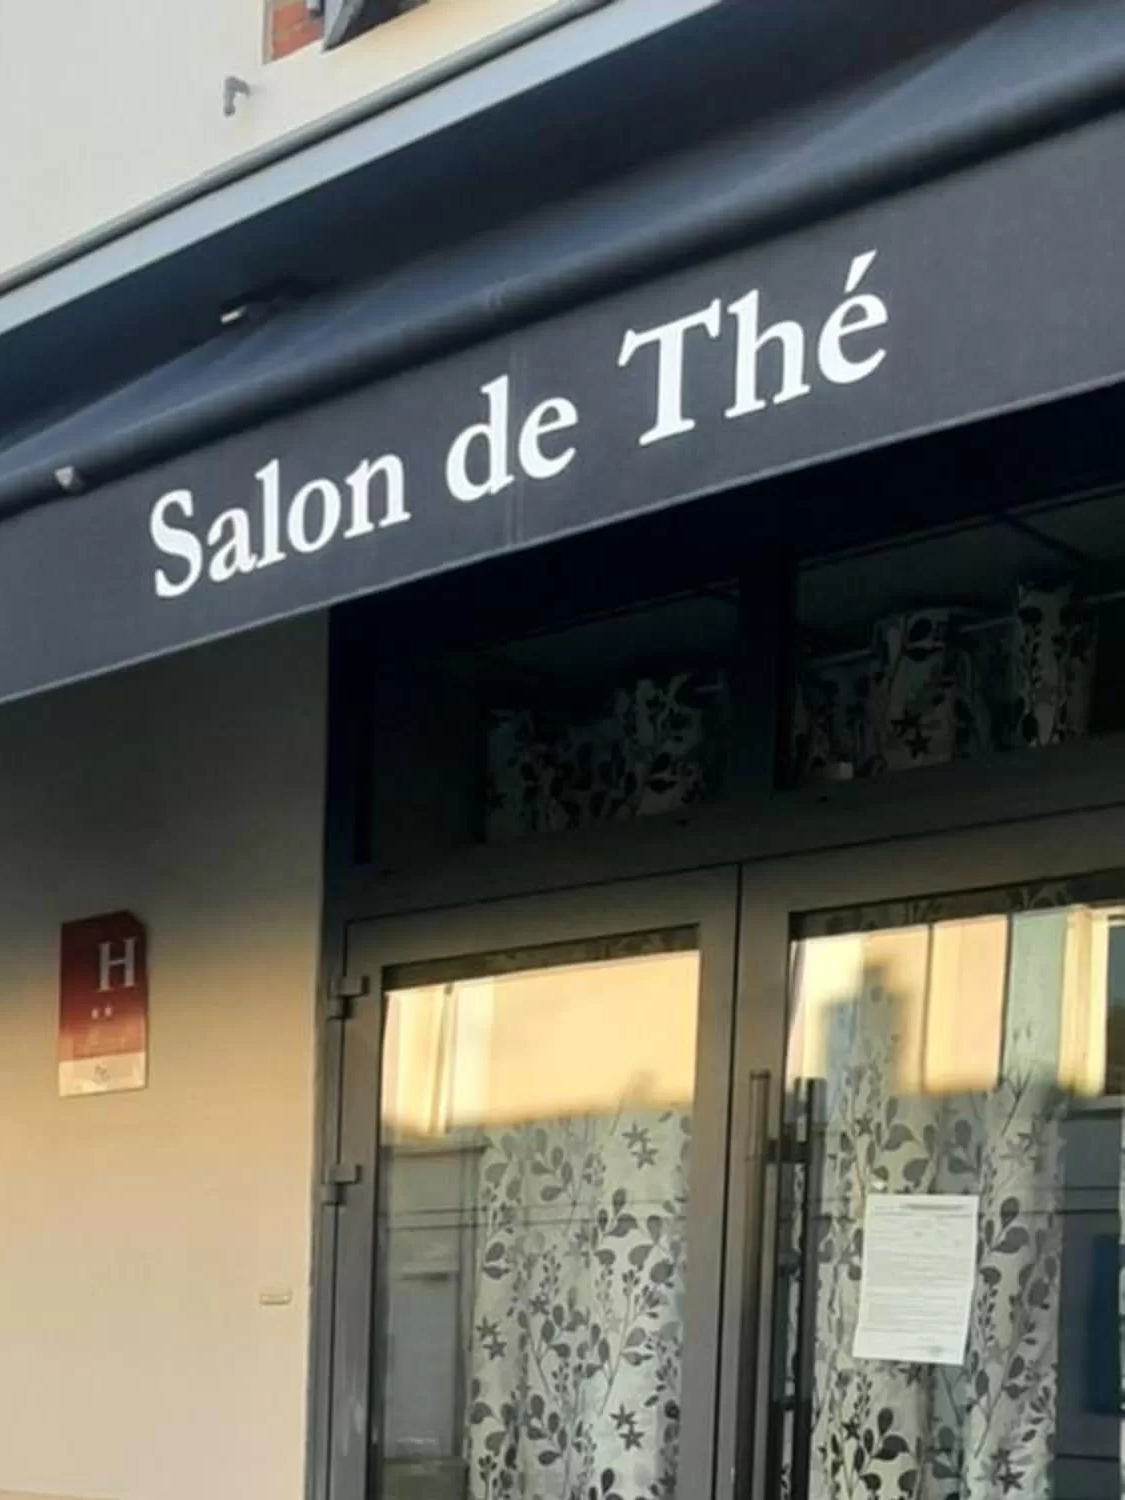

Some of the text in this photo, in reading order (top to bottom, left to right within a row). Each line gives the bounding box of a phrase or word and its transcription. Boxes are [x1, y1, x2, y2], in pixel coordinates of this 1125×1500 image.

[149, 250, 888, 598] Salon de Thé
[97, 936, 136, 993] H
